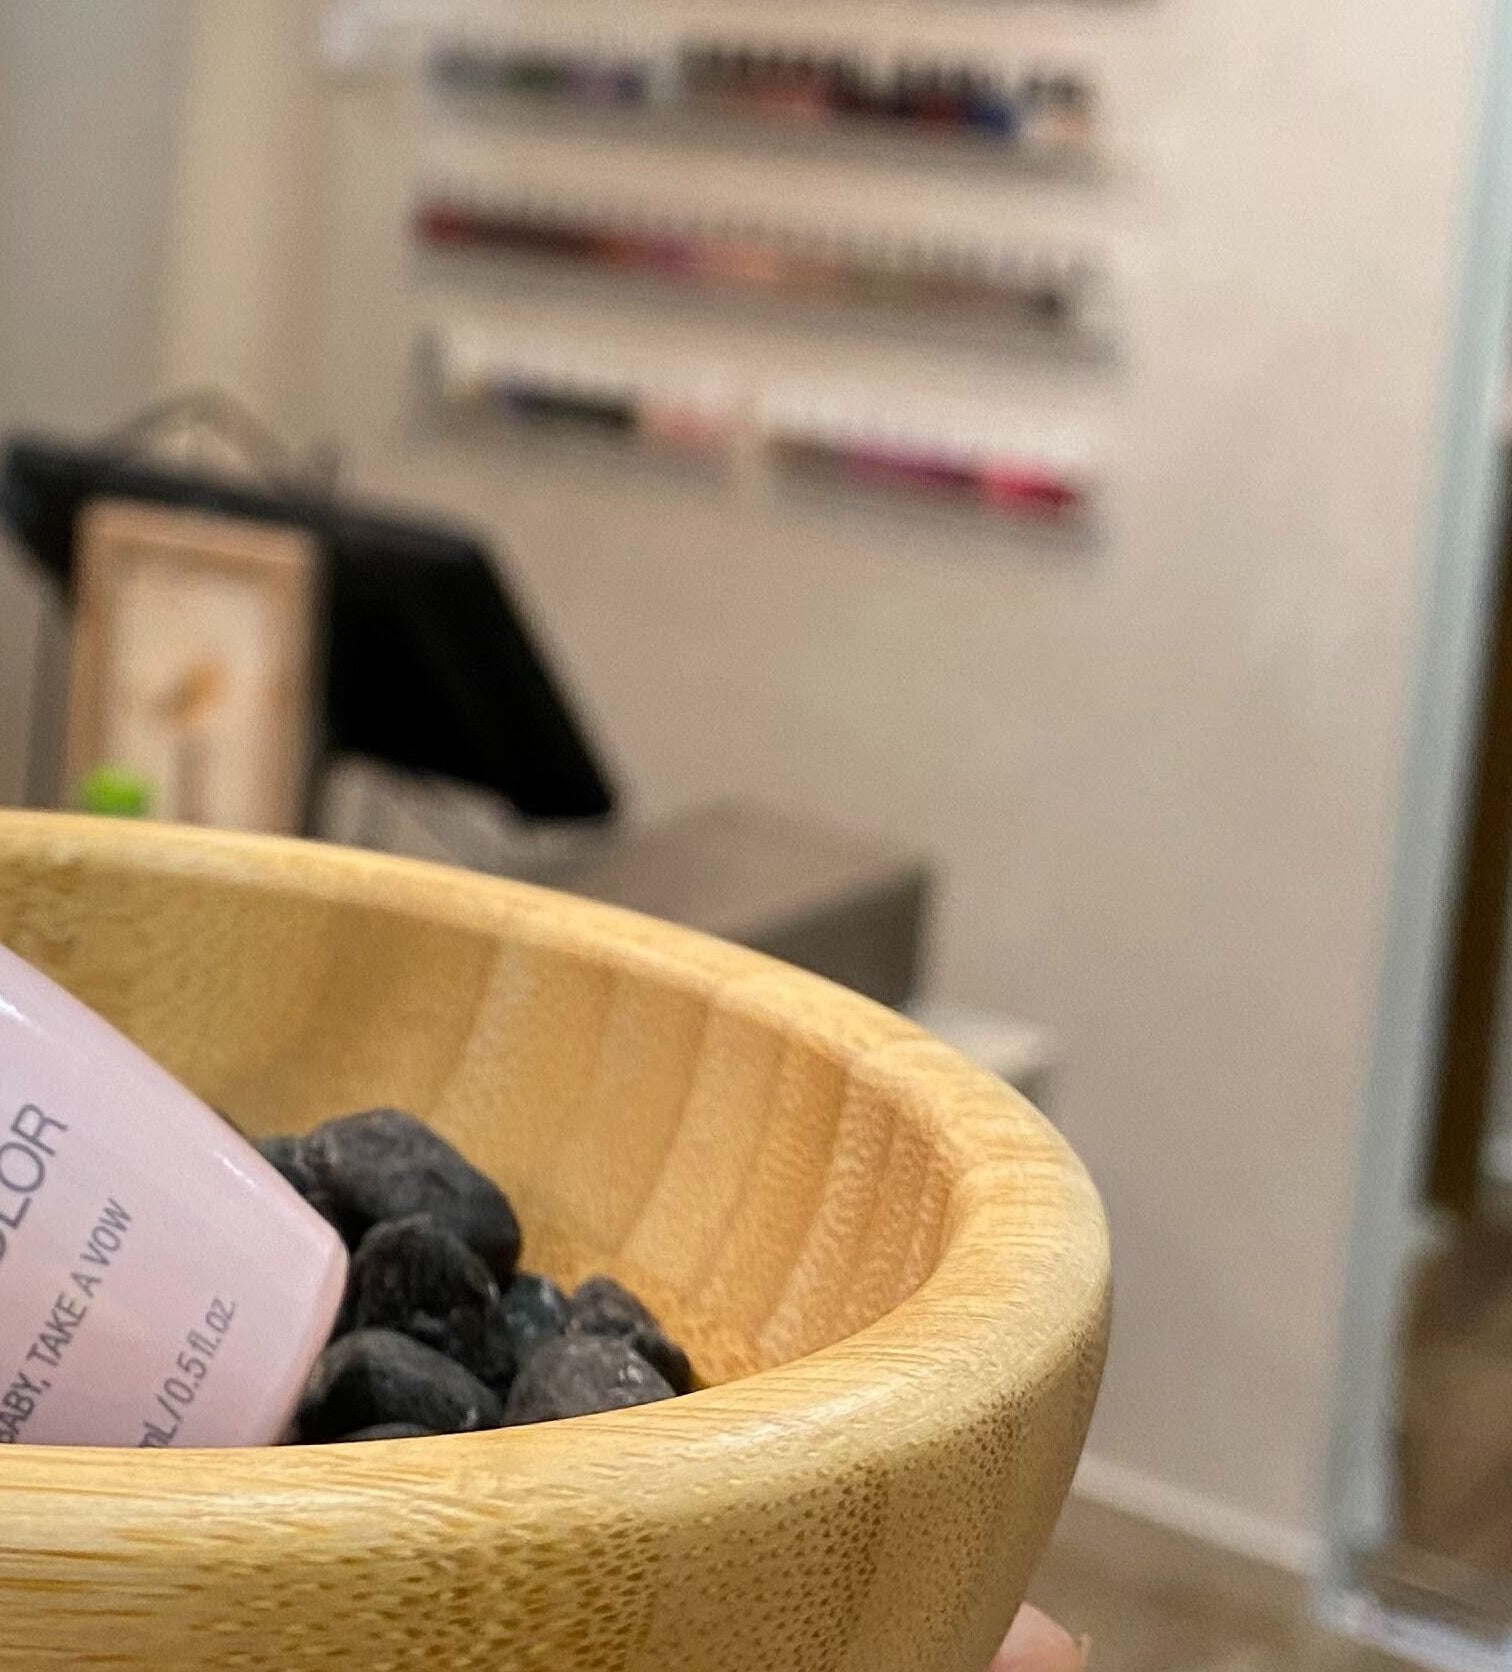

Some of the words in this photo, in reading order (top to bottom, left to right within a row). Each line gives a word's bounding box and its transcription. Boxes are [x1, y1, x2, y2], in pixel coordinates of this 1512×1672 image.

[81, 1199, 132, 1267] VOW
[70, 1271, 102, 1300] A
[27, 1293, 88, 1367] TAKE
